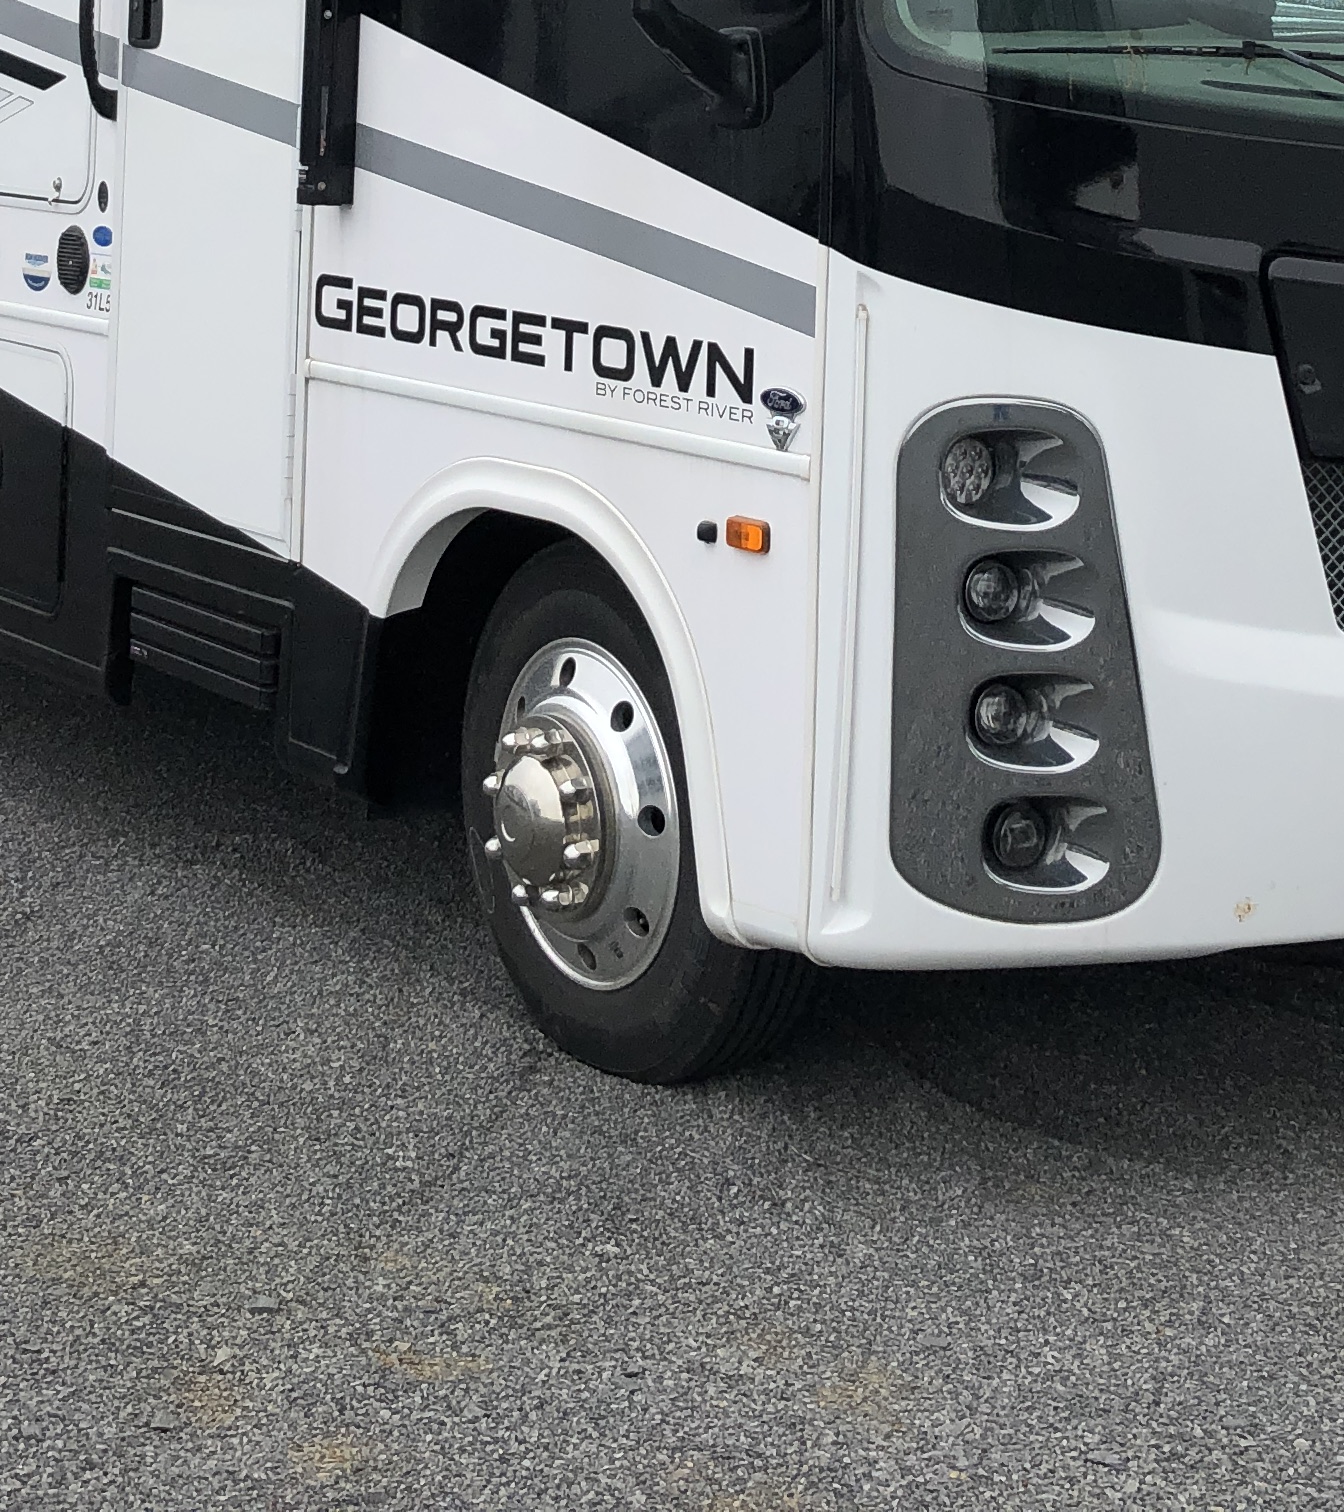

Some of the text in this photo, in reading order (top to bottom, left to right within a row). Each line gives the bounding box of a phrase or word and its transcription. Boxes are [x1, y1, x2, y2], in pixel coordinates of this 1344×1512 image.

[315, 273, 754, 405] GEORGETOWN
[595, 381, 755, 424] BY FOREST RIVER
[766, 390, 793, 411] Ford
